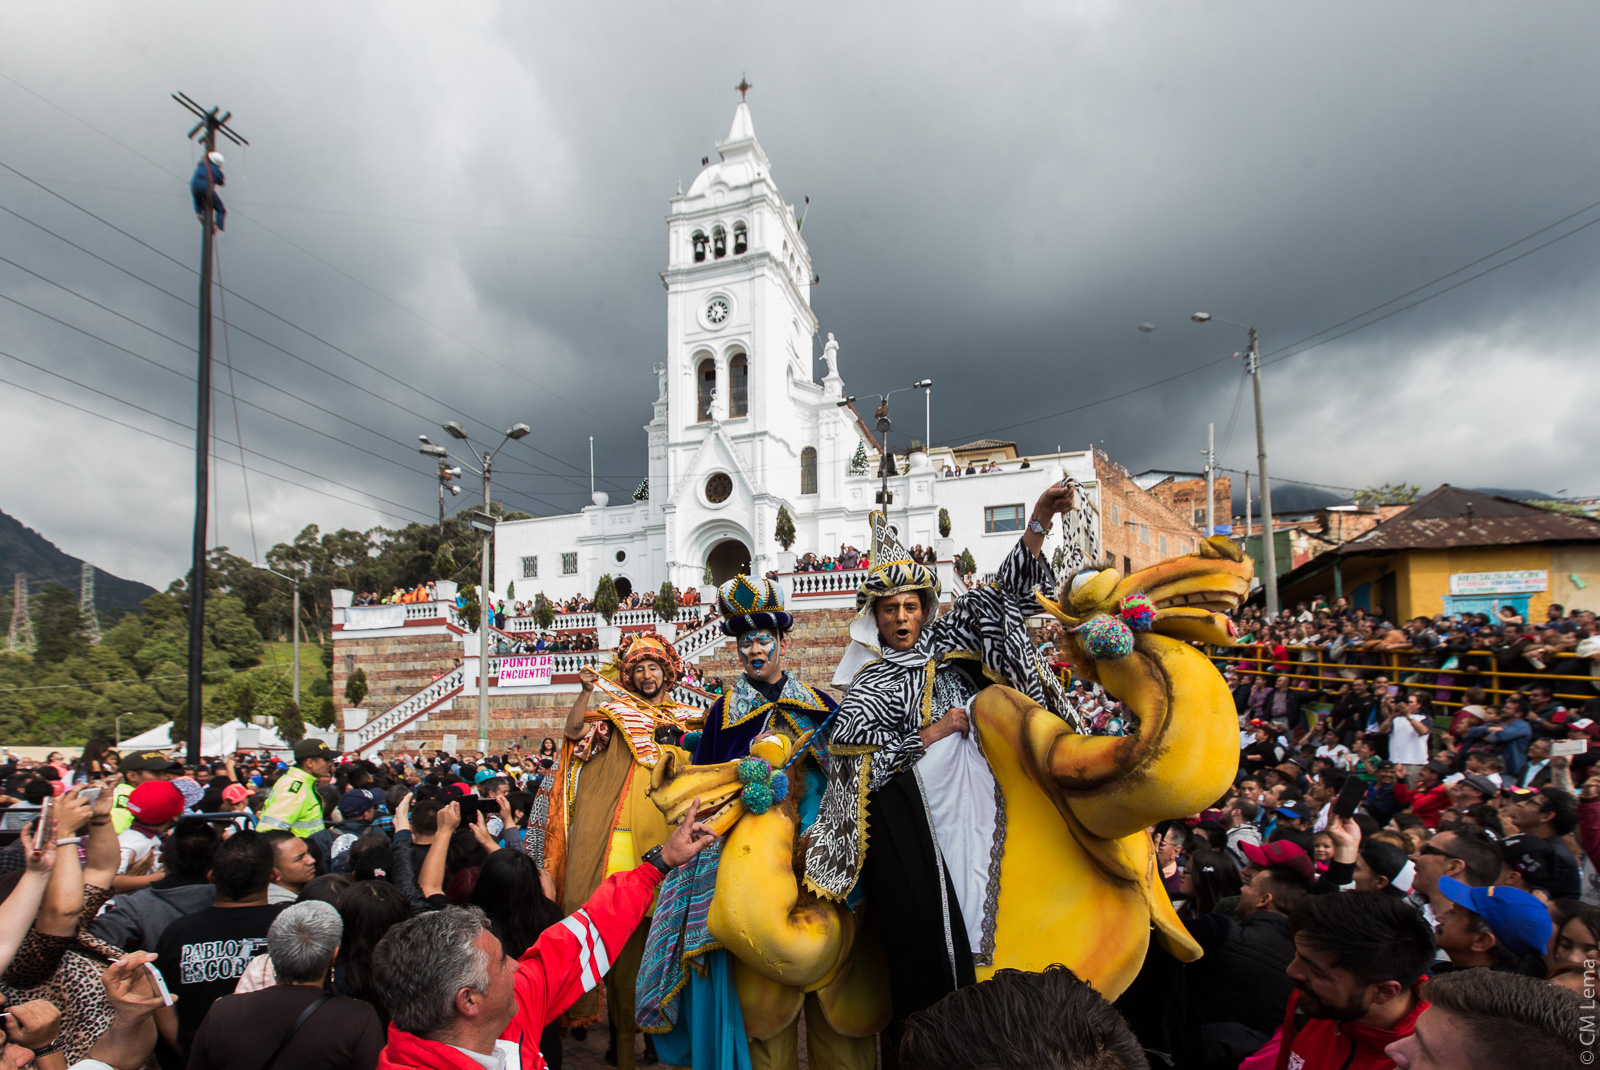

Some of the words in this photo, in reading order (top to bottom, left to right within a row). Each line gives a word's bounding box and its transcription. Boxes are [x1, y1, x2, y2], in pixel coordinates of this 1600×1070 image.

[503, 657, 537, 668] PUNTO
[540, 656, 552, 666] DE
[501, 667, 552, 680] ENCUENTRO
[181, 940, 238, 963] PABLO
[180, 956, 256, 984] ESCOB
